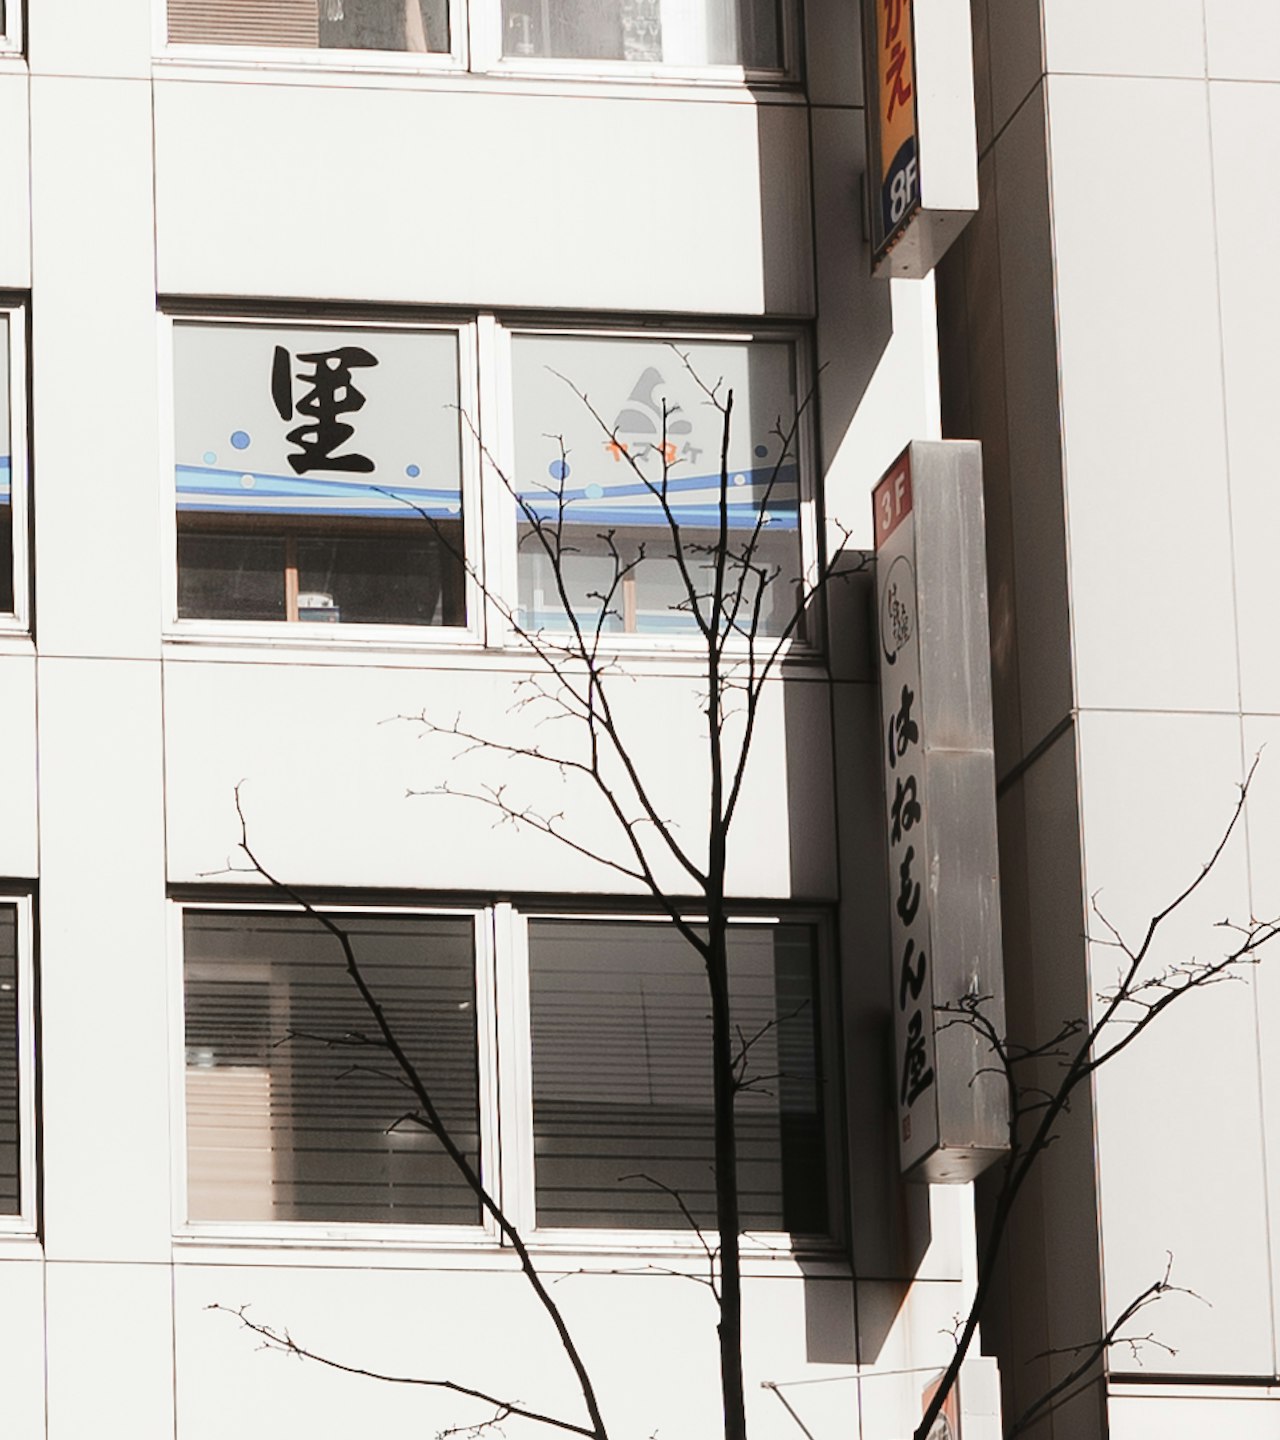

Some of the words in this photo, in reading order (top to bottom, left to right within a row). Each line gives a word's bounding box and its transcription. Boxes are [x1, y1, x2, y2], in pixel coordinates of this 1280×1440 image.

[887, 154, 920, 224] 8F
[880, 473, 909, 531] 3F
[887, 683, 935, 1108] はねもん屋
